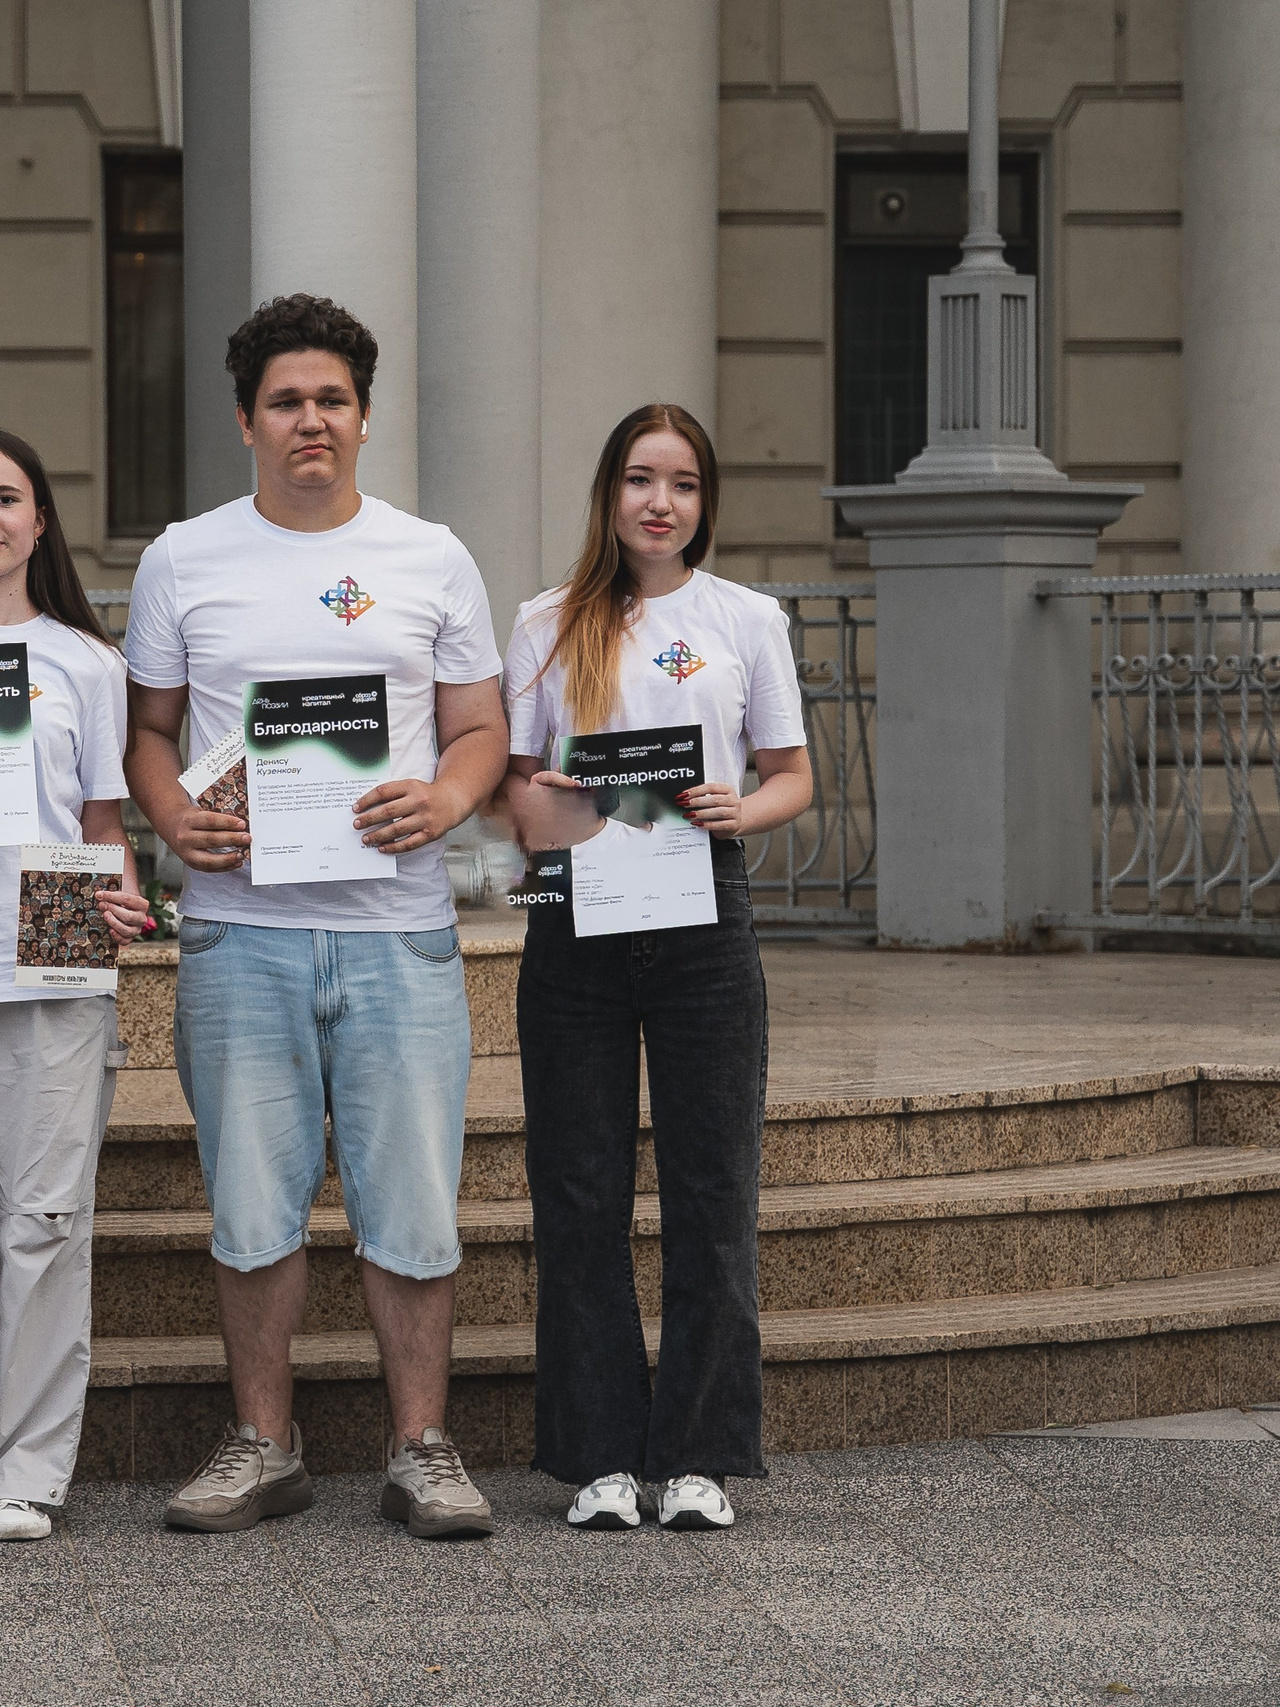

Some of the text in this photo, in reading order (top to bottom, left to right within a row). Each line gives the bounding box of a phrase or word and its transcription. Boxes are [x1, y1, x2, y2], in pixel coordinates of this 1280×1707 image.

[254, 719, 379, 736] Благодарность
[256, 758, 289, 767] Денису
[256, 767, 302, 777] Кузенкову
